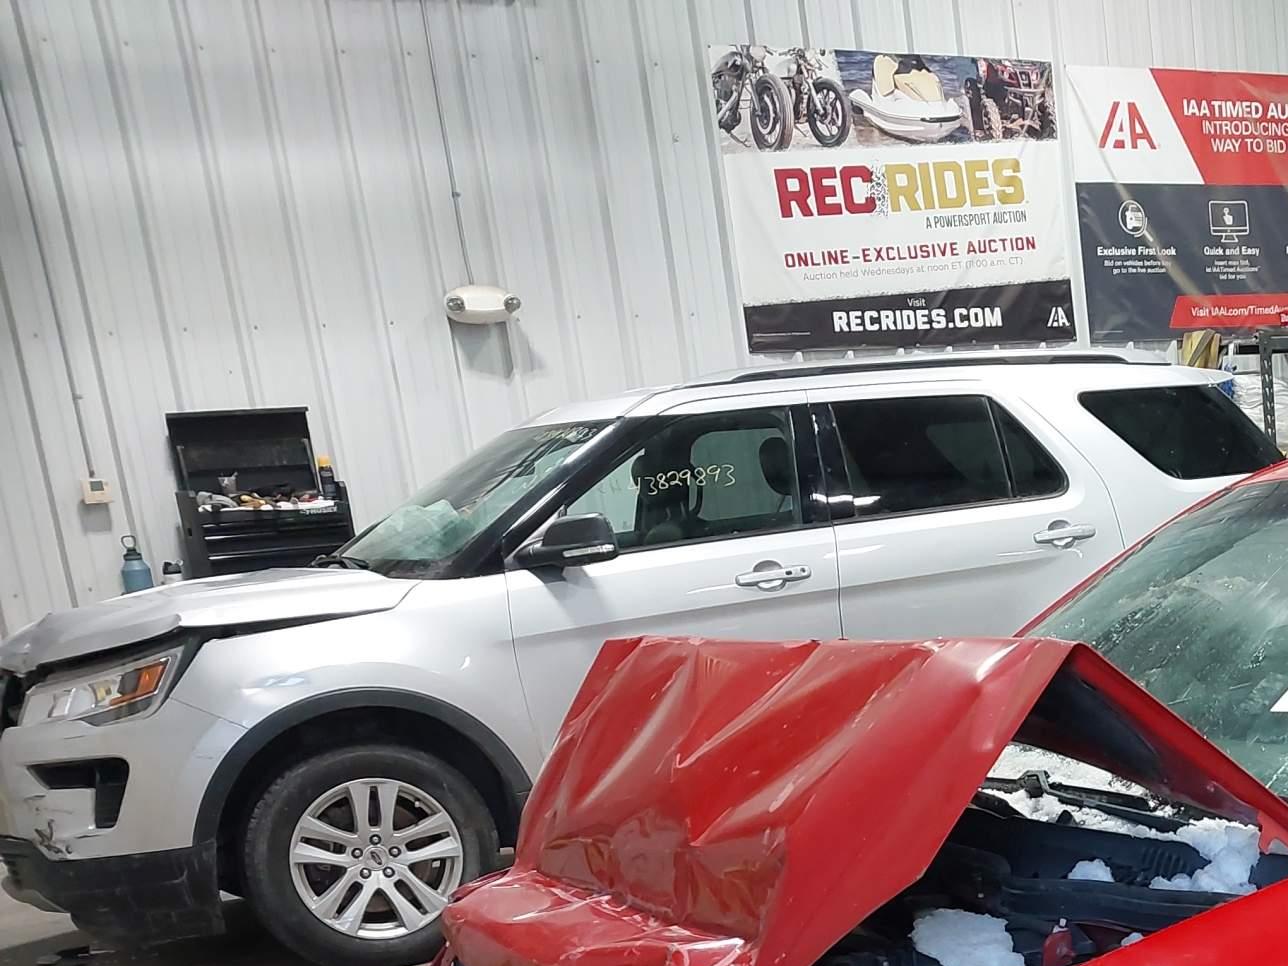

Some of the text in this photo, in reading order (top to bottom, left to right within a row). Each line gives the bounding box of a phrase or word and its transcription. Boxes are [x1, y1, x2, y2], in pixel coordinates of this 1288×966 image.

[1183, 99, 1211, 117] IAA
[1211, 100, 1263, 118] TIMED
[1211, 138, 1242, 153] WAY
[1244, 138, 1264, 153] TO
[1266, 139, 1287, 154] BID
[774, 158, 1025, 218] REC RIDES
[926, 210, 1027, 229] A POWERSPORT AUCTION
[784, 236, 1037, 268] ONLINE-EXCLUSIVE AUCTION
[1097, 246, 1136, 256] Exclusive
[1138, 246, 1156, 255] First
[1203, 246, 1260, 257] Quick and Easy
[803, 269, 837, 281] Auction
[839, 268, 859, 279] held
[862, 265, 914, 277] Wednesdays
[916, 264, 925, 273] at
[927, 263, 949, 272] noon
[951, 261, 962, 270] ET
[907, 297, 926, 307] Visit
[1191, 305, 1209, 317] Visit
[833, 306, 1003, 332] RECRIDES.COM
[628, 464, 736, 495] 43829893
